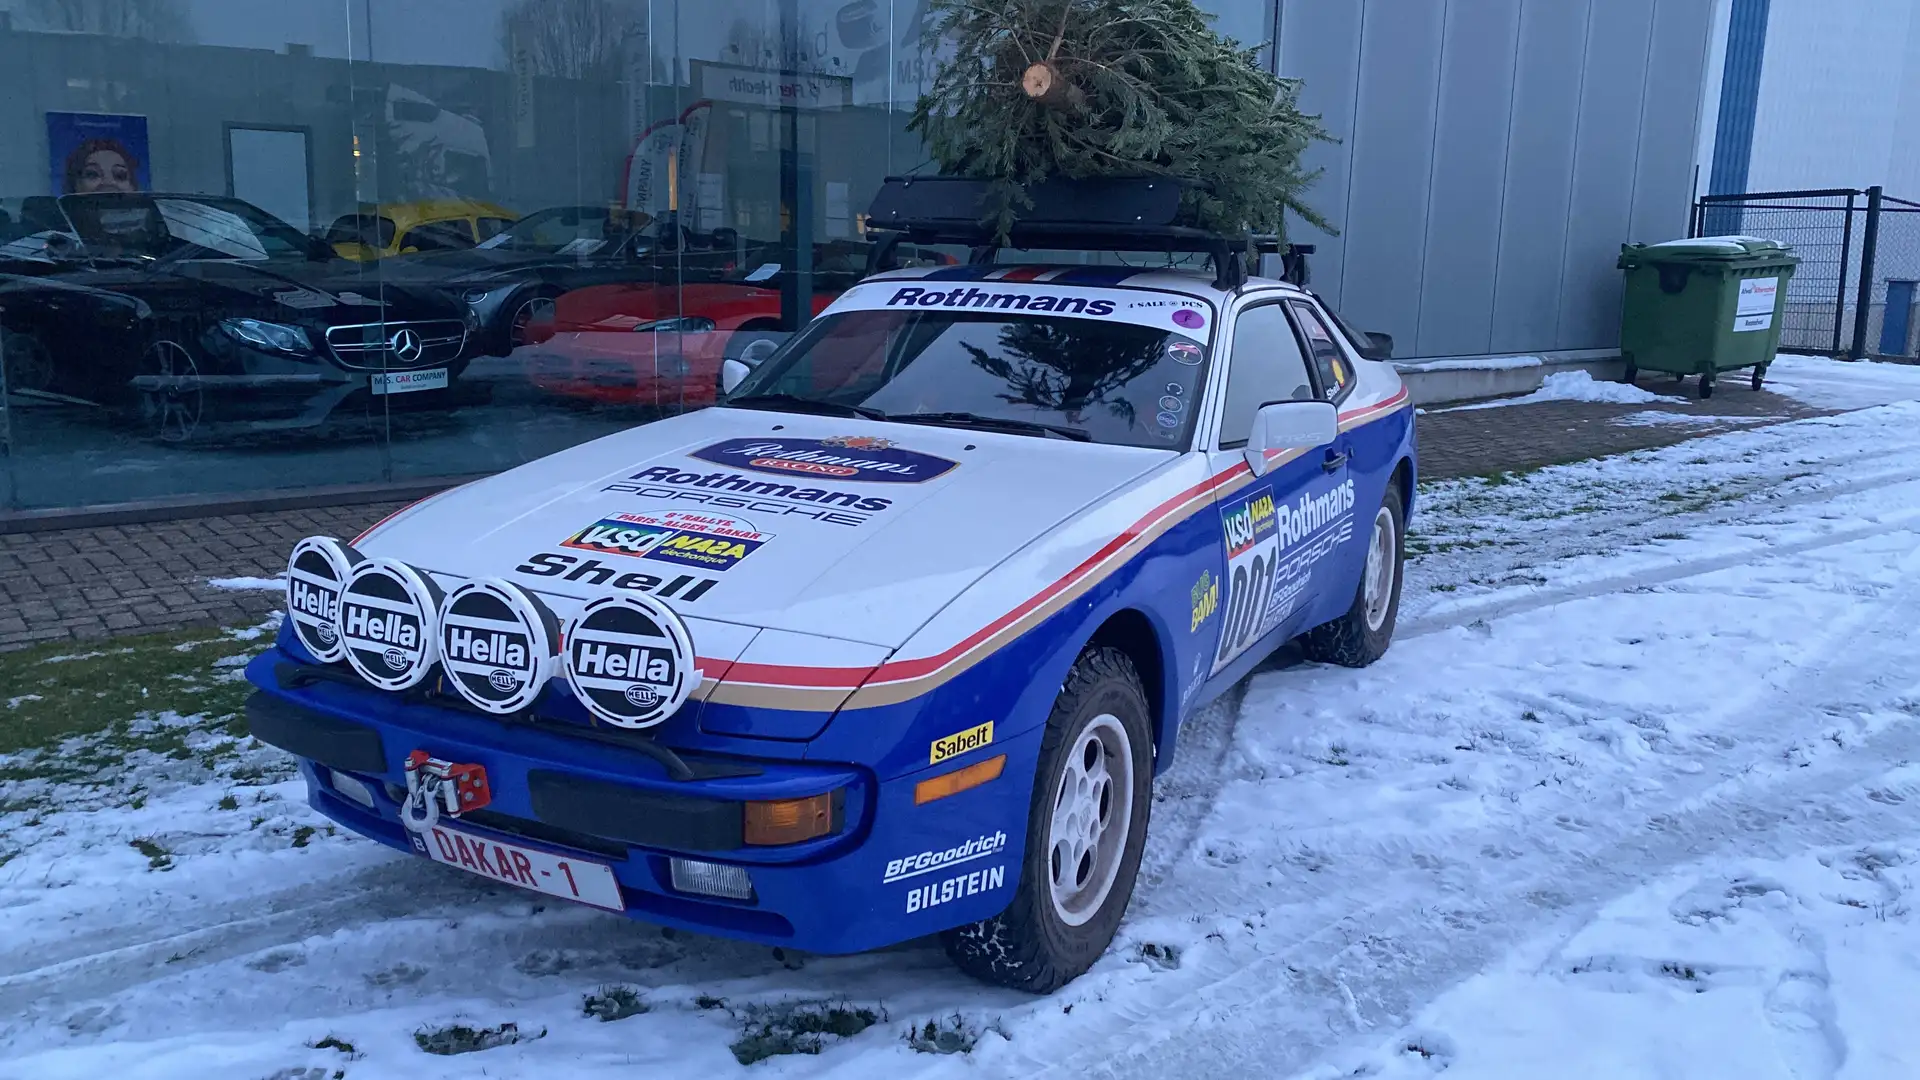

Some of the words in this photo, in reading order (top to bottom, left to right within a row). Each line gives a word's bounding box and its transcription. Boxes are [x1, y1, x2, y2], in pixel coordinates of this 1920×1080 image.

[886, 286, 1117, 316] Rothmans
[1137, 300, 1167, 308] SALE
[1181, 301, 1204, 309] PCS
[395, 374, 411, 384] CAR
[412, 371, 446, 382] COMPANY
[722, 441, 919, 476] Rothmans
[762, 458, 850, 475] RACING
[600, 484, 874, 528] PORSCHE
[629, 465, 894, 513] Rothmans
[616, 512, 762, 541] PARIS-ALGER-DAKAR
[1277, 477, 1356, 553] Rothmans
[1274, 520, 1354, 588] PORSCHE
[514, 551, 720, 603] Shell
[293, 580, 337, 622] Hella
[1190, 575, 1219, 633] BAM!
[1219, 545, 1279, 663] 001
[346, 606, 417, 648] Hella
[385, 653, 408, 666] HELLA
[449, 628, 525, 668] Hella
[578, 643, 670, 682] Hella
[490, 674, 518, 687] HELLA
[628, 690, 659, 702] HELLA
[934, 725, 988, 760] Sabelt
[412, 835, 426, 852] B
[884, 829, 1007, 879] BFGoodrich
[906, 865, 1005, 914] BILSTEIN
